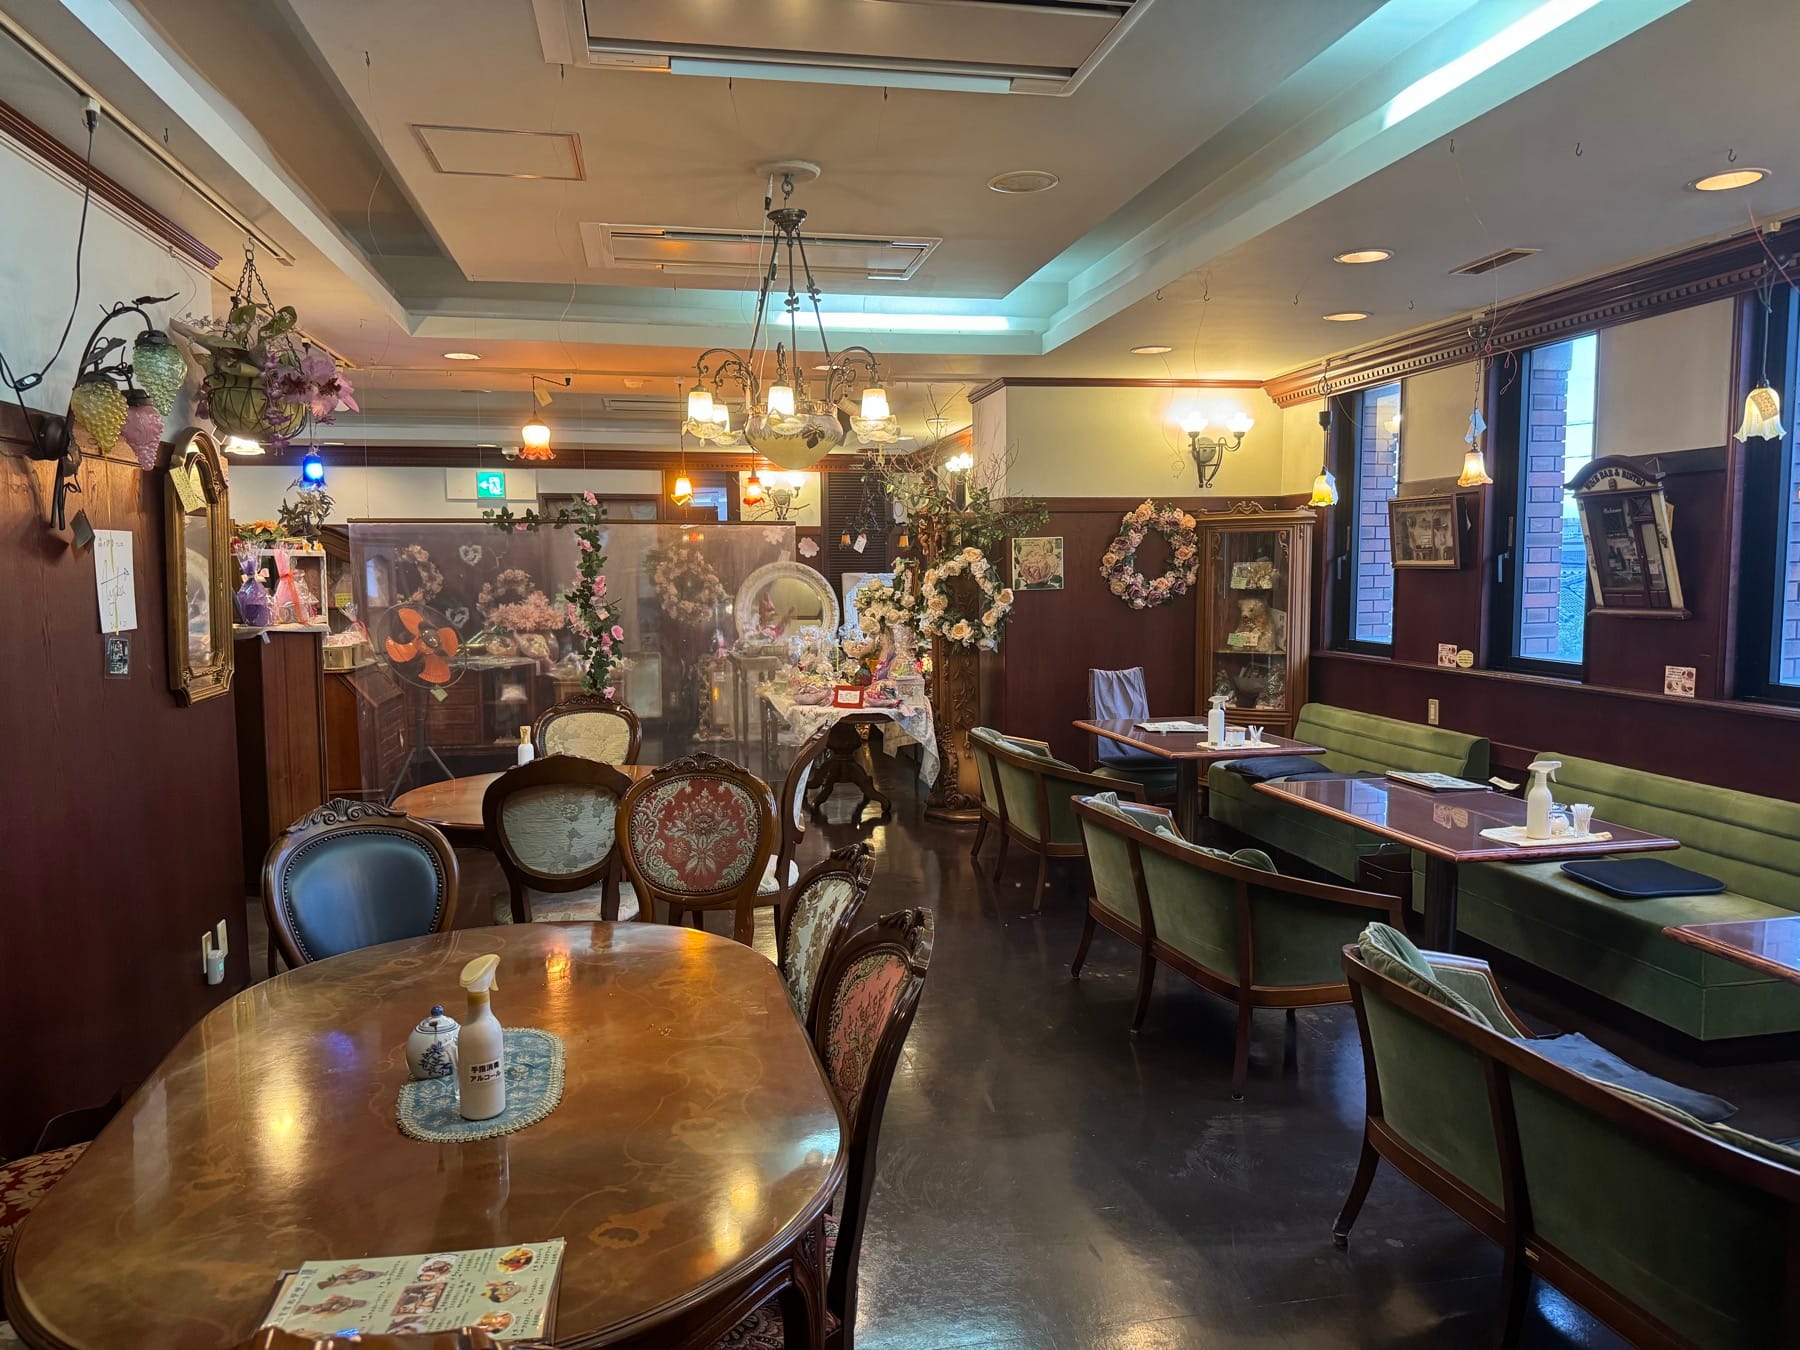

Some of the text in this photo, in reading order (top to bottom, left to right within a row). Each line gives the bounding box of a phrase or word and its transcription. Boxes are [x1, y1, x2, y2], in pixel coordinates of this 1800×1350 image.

[1599, 470, 1613, 480] BAR
[1615, 468, 1620, 477] &
[1622, 470, 1646, 487] BISTRO
[471, 1061, 499, 1074] 手指消毒
[470, 1070, 501, 1082] アルコール
